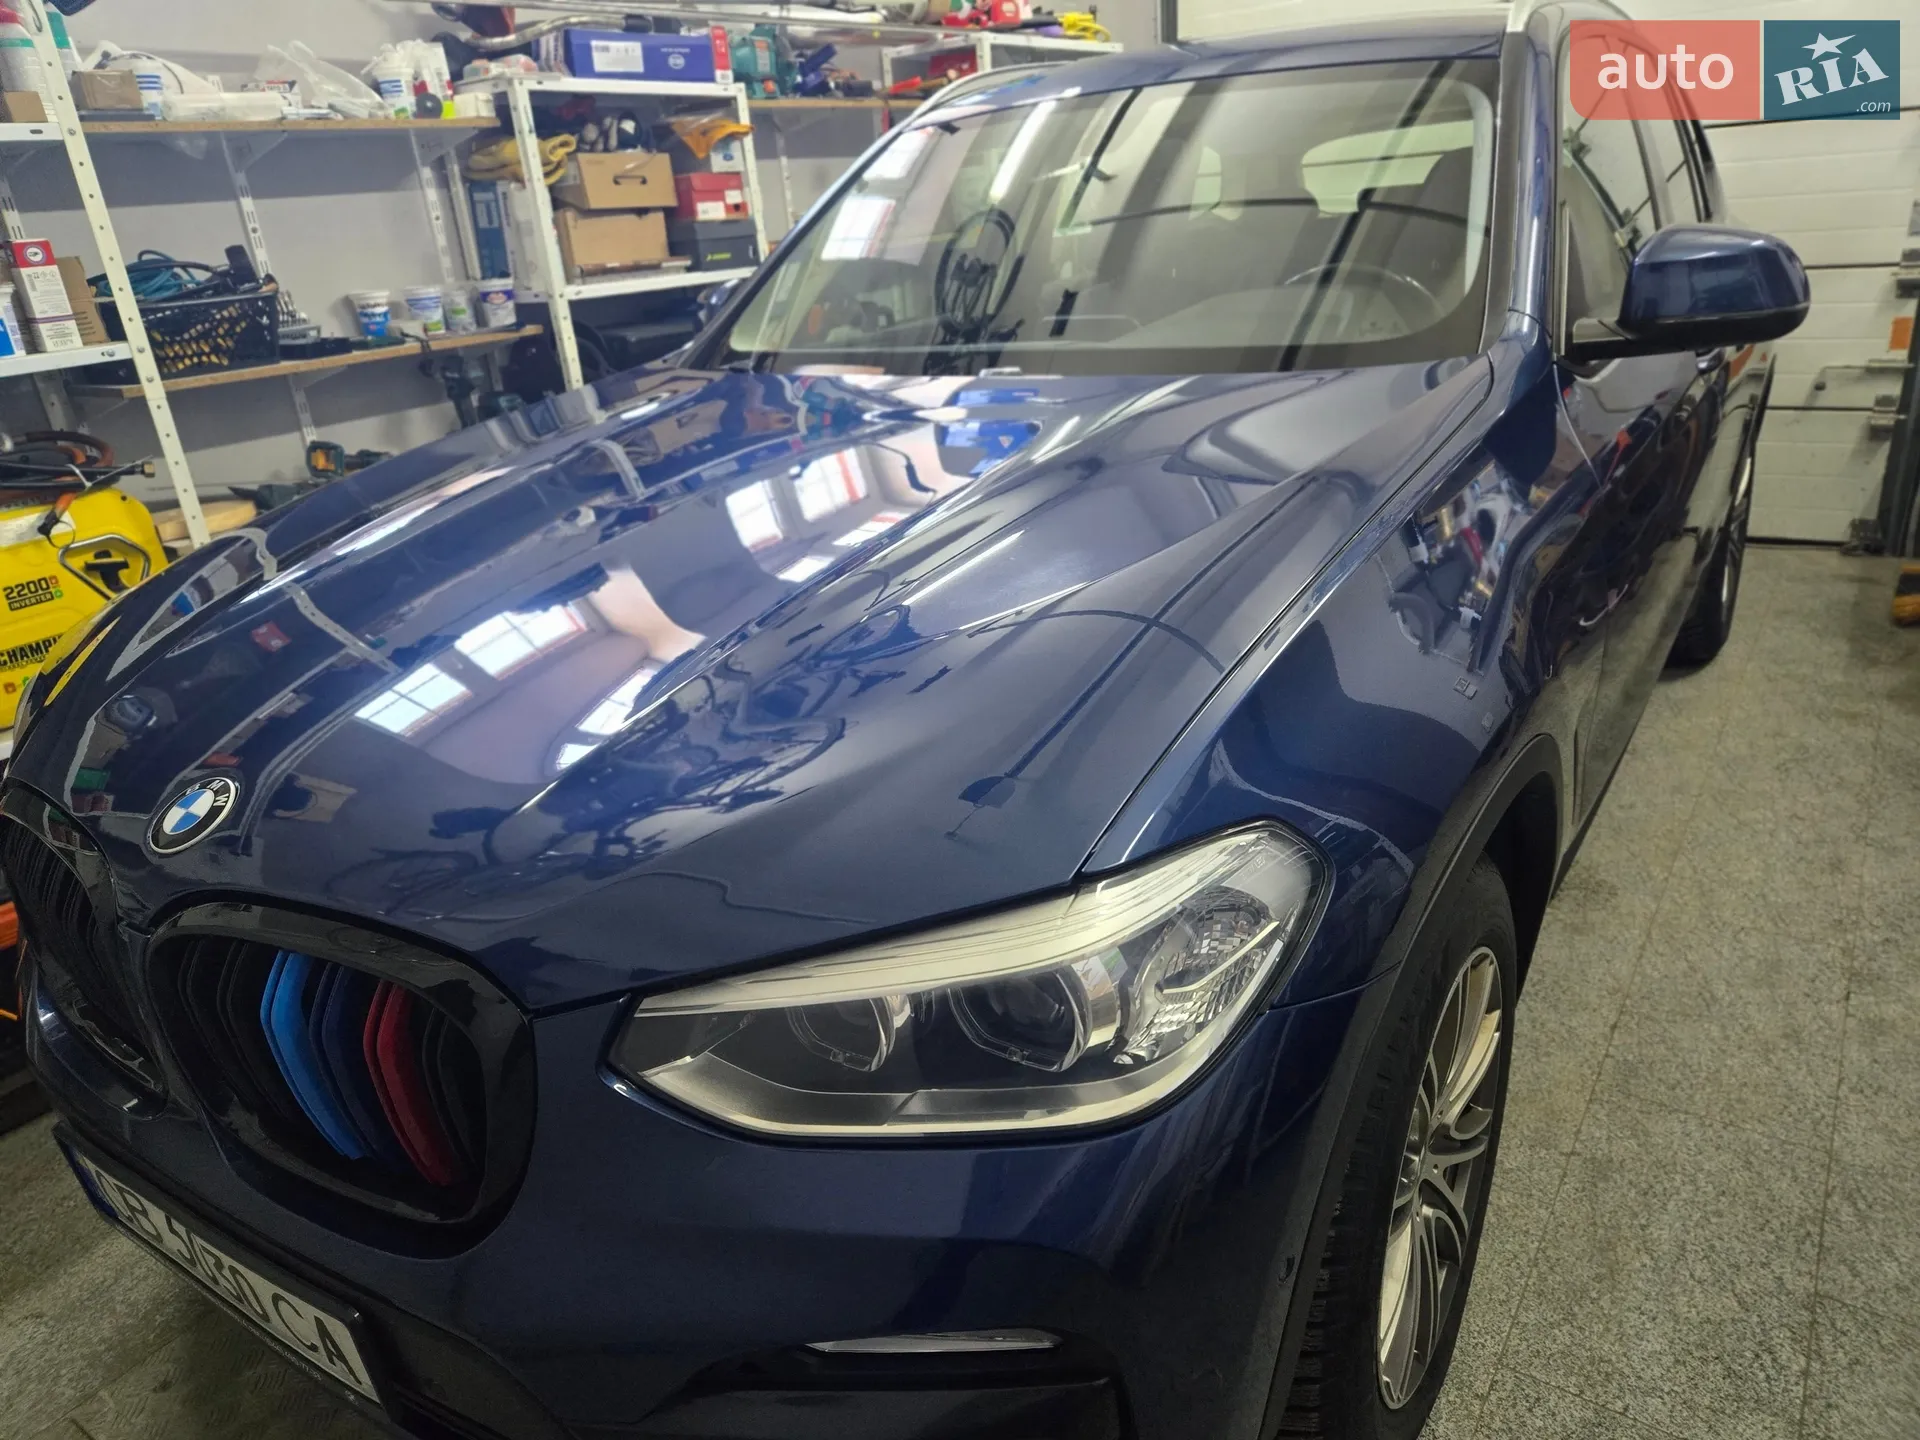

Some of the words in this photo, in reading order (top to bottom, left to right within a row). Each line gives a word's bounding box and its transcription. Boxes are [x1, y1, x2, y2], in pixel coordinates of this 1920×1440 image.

[2, 577, 51, 602] 2200
[10, 592, 53, 610] INVERTER
[0, 634, 62, 667] CHAMPI
[185, 779, 230, 807] BMW
[94, 1168, 164, 1245] CB
[271, 1291, 363, 1386] CA
